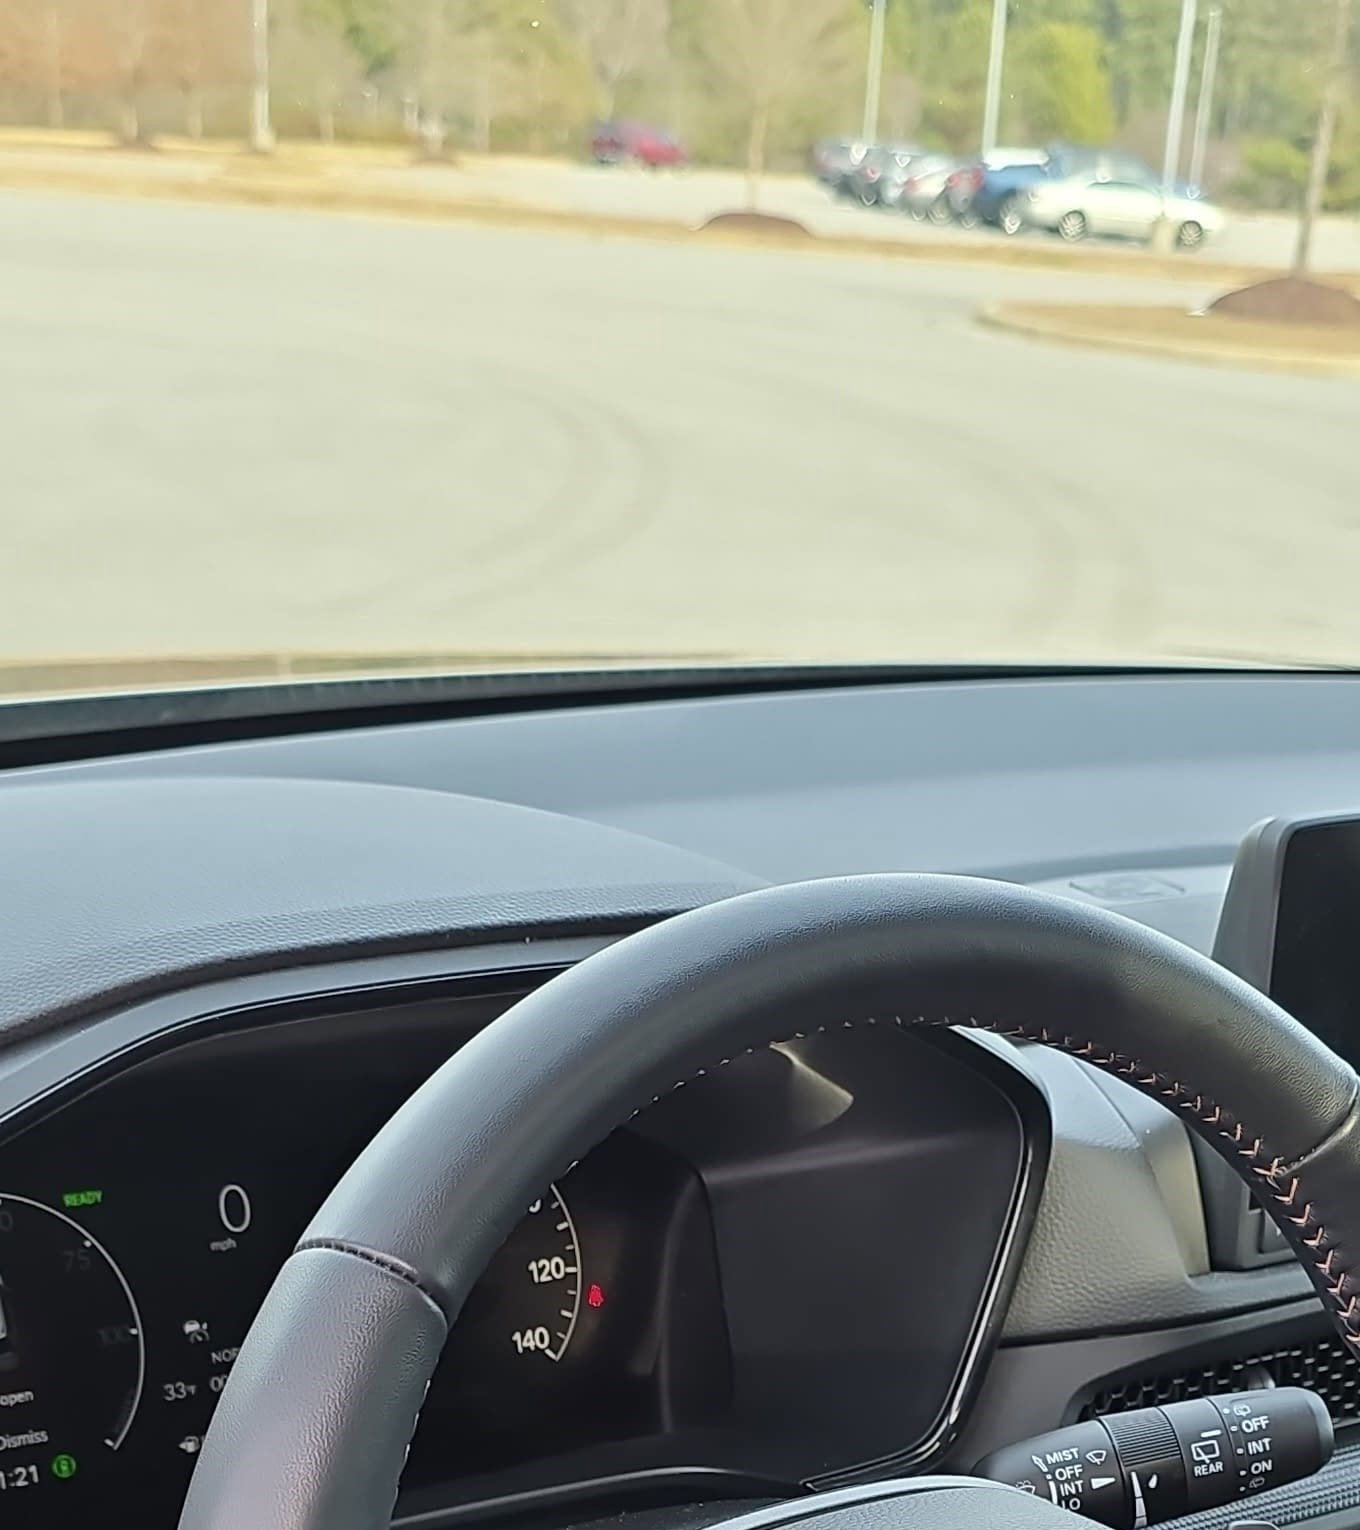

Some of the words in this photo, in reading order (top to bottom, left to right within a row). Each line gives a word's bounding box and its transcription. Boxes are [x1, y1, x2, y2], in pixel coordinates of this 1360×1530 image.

[63, 1190, 103, 1208] READY
[218, 1184, 251, 1233] 0
[210, 1237, 237, 1254] mph
[527, 1256, 565, 1283] 120
[512, 1326, 550, 1353] 140
[0, 1389, 35, 1407] open
[1242, 1416, 1270, 1433] OFF
[1247, 1438, 1273, 1455] INT
[1046, 1448, 1080, 1465] MIST
[1055, 1464, 1084, 1481] OFF
[1193, 1461, 1224, 1477] REAR
[1250, 1460, 1273, 1475] ON
[1059, 1480, 1085, 1496] INT
